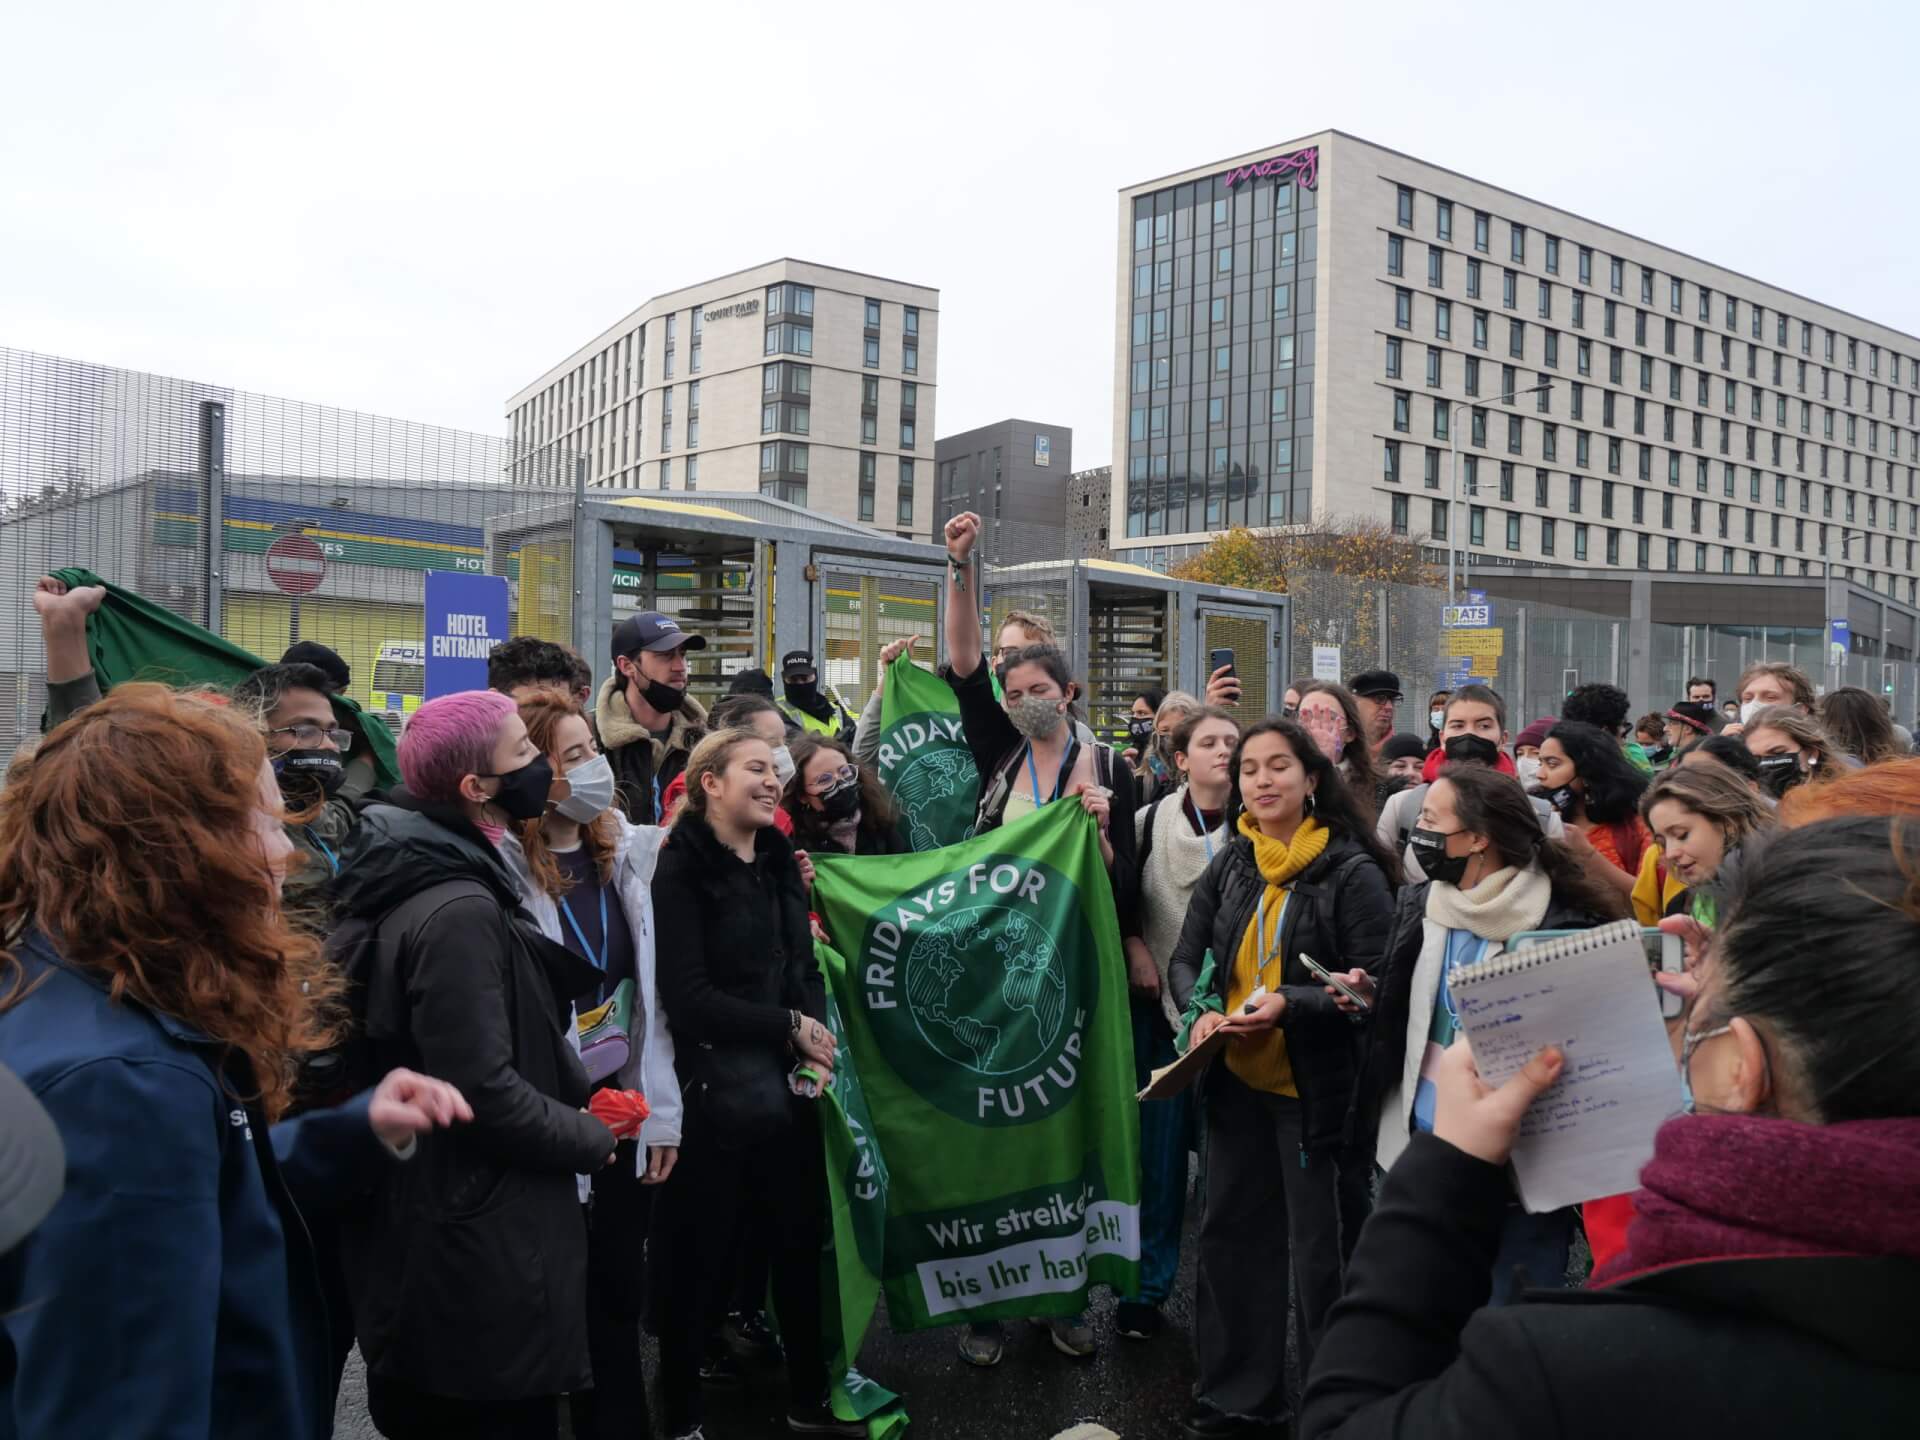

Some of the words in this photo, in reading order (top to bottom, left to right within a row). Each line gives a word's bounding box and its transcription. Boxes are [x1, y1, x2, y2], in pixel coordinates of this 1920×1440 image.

[447, 613, 489, 637] HOTEL
[1460, 607, 1487, 620] ATS
[787, 657, 808, 665] POLICE
[866, 880, 956, 1010] FRIDAYS
[969, 864, 1046, 905] FOR
[926, 1218, 984, 1249] Wir
[935, 1270, 981, 1300] bis
[987, 1260, 1031, 1290] Ihr
